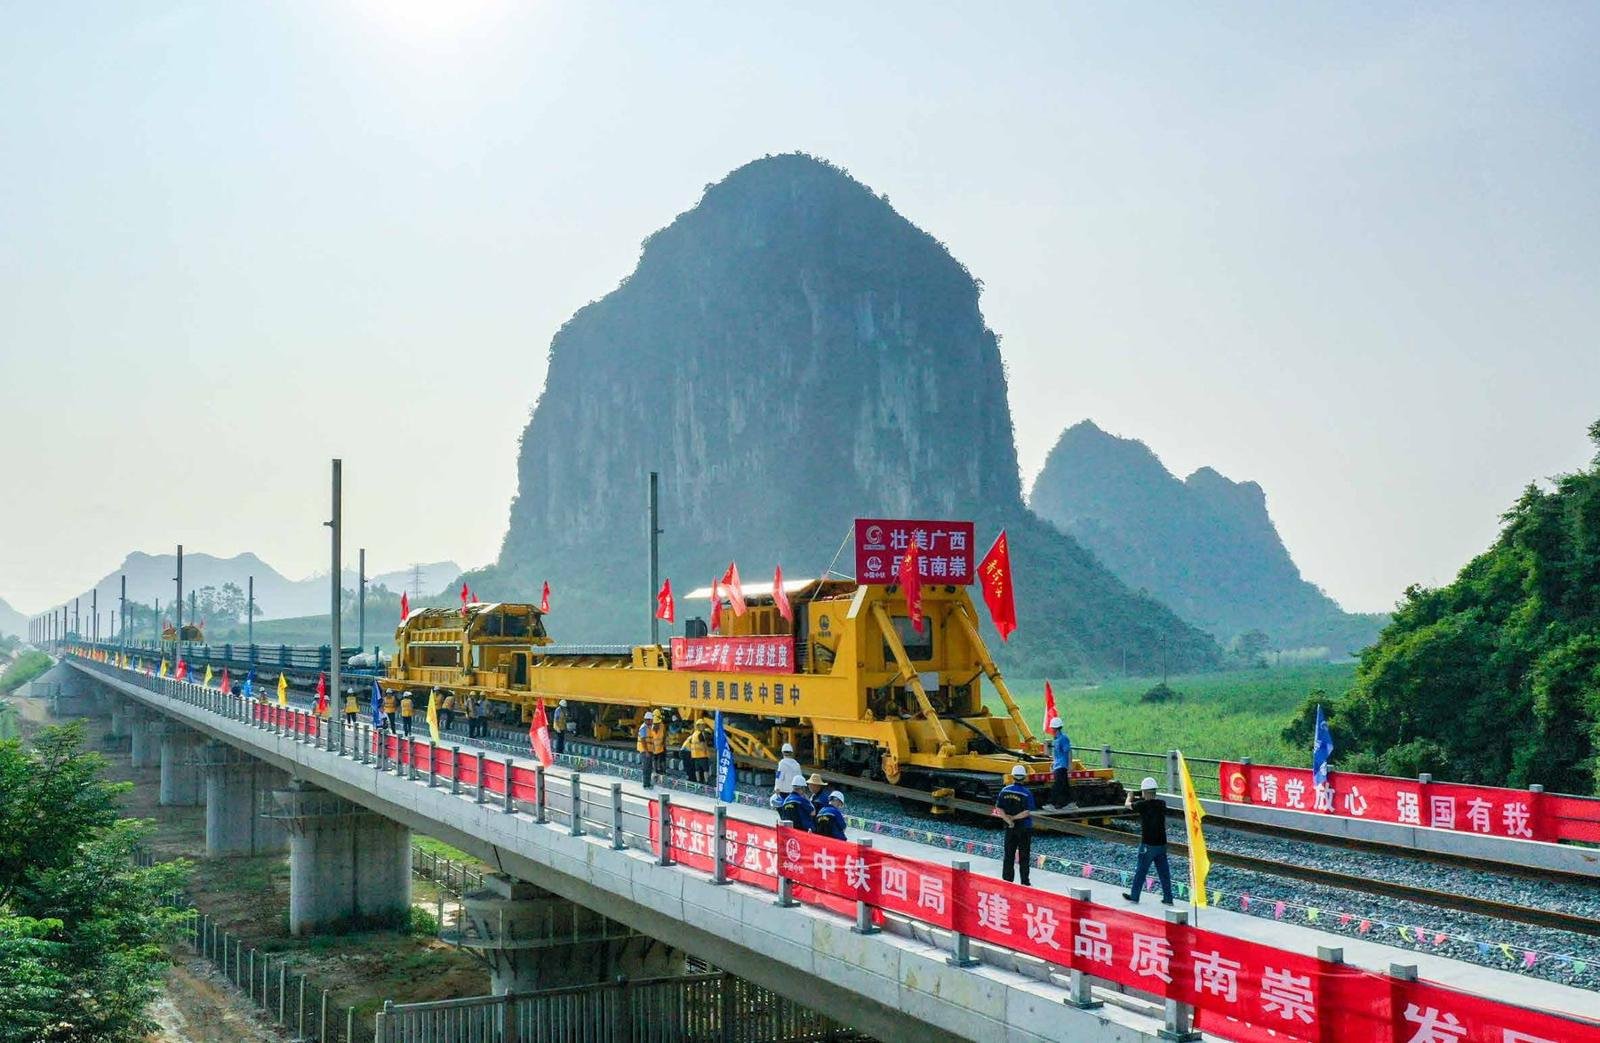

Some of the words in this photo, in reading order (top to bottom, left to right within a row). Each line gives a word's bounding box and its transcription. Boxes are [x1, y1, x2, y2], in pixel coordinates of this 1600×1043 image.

[891, 529, 967, 551] 壮美广西
[1258, 774, 1367, 816] 请党放心
[1397, 791, 1532, 838] 强国有我
[813, 848, 945, 915] 中铁四局
[977, 891, 1316, 1026] 建设品质南崇
